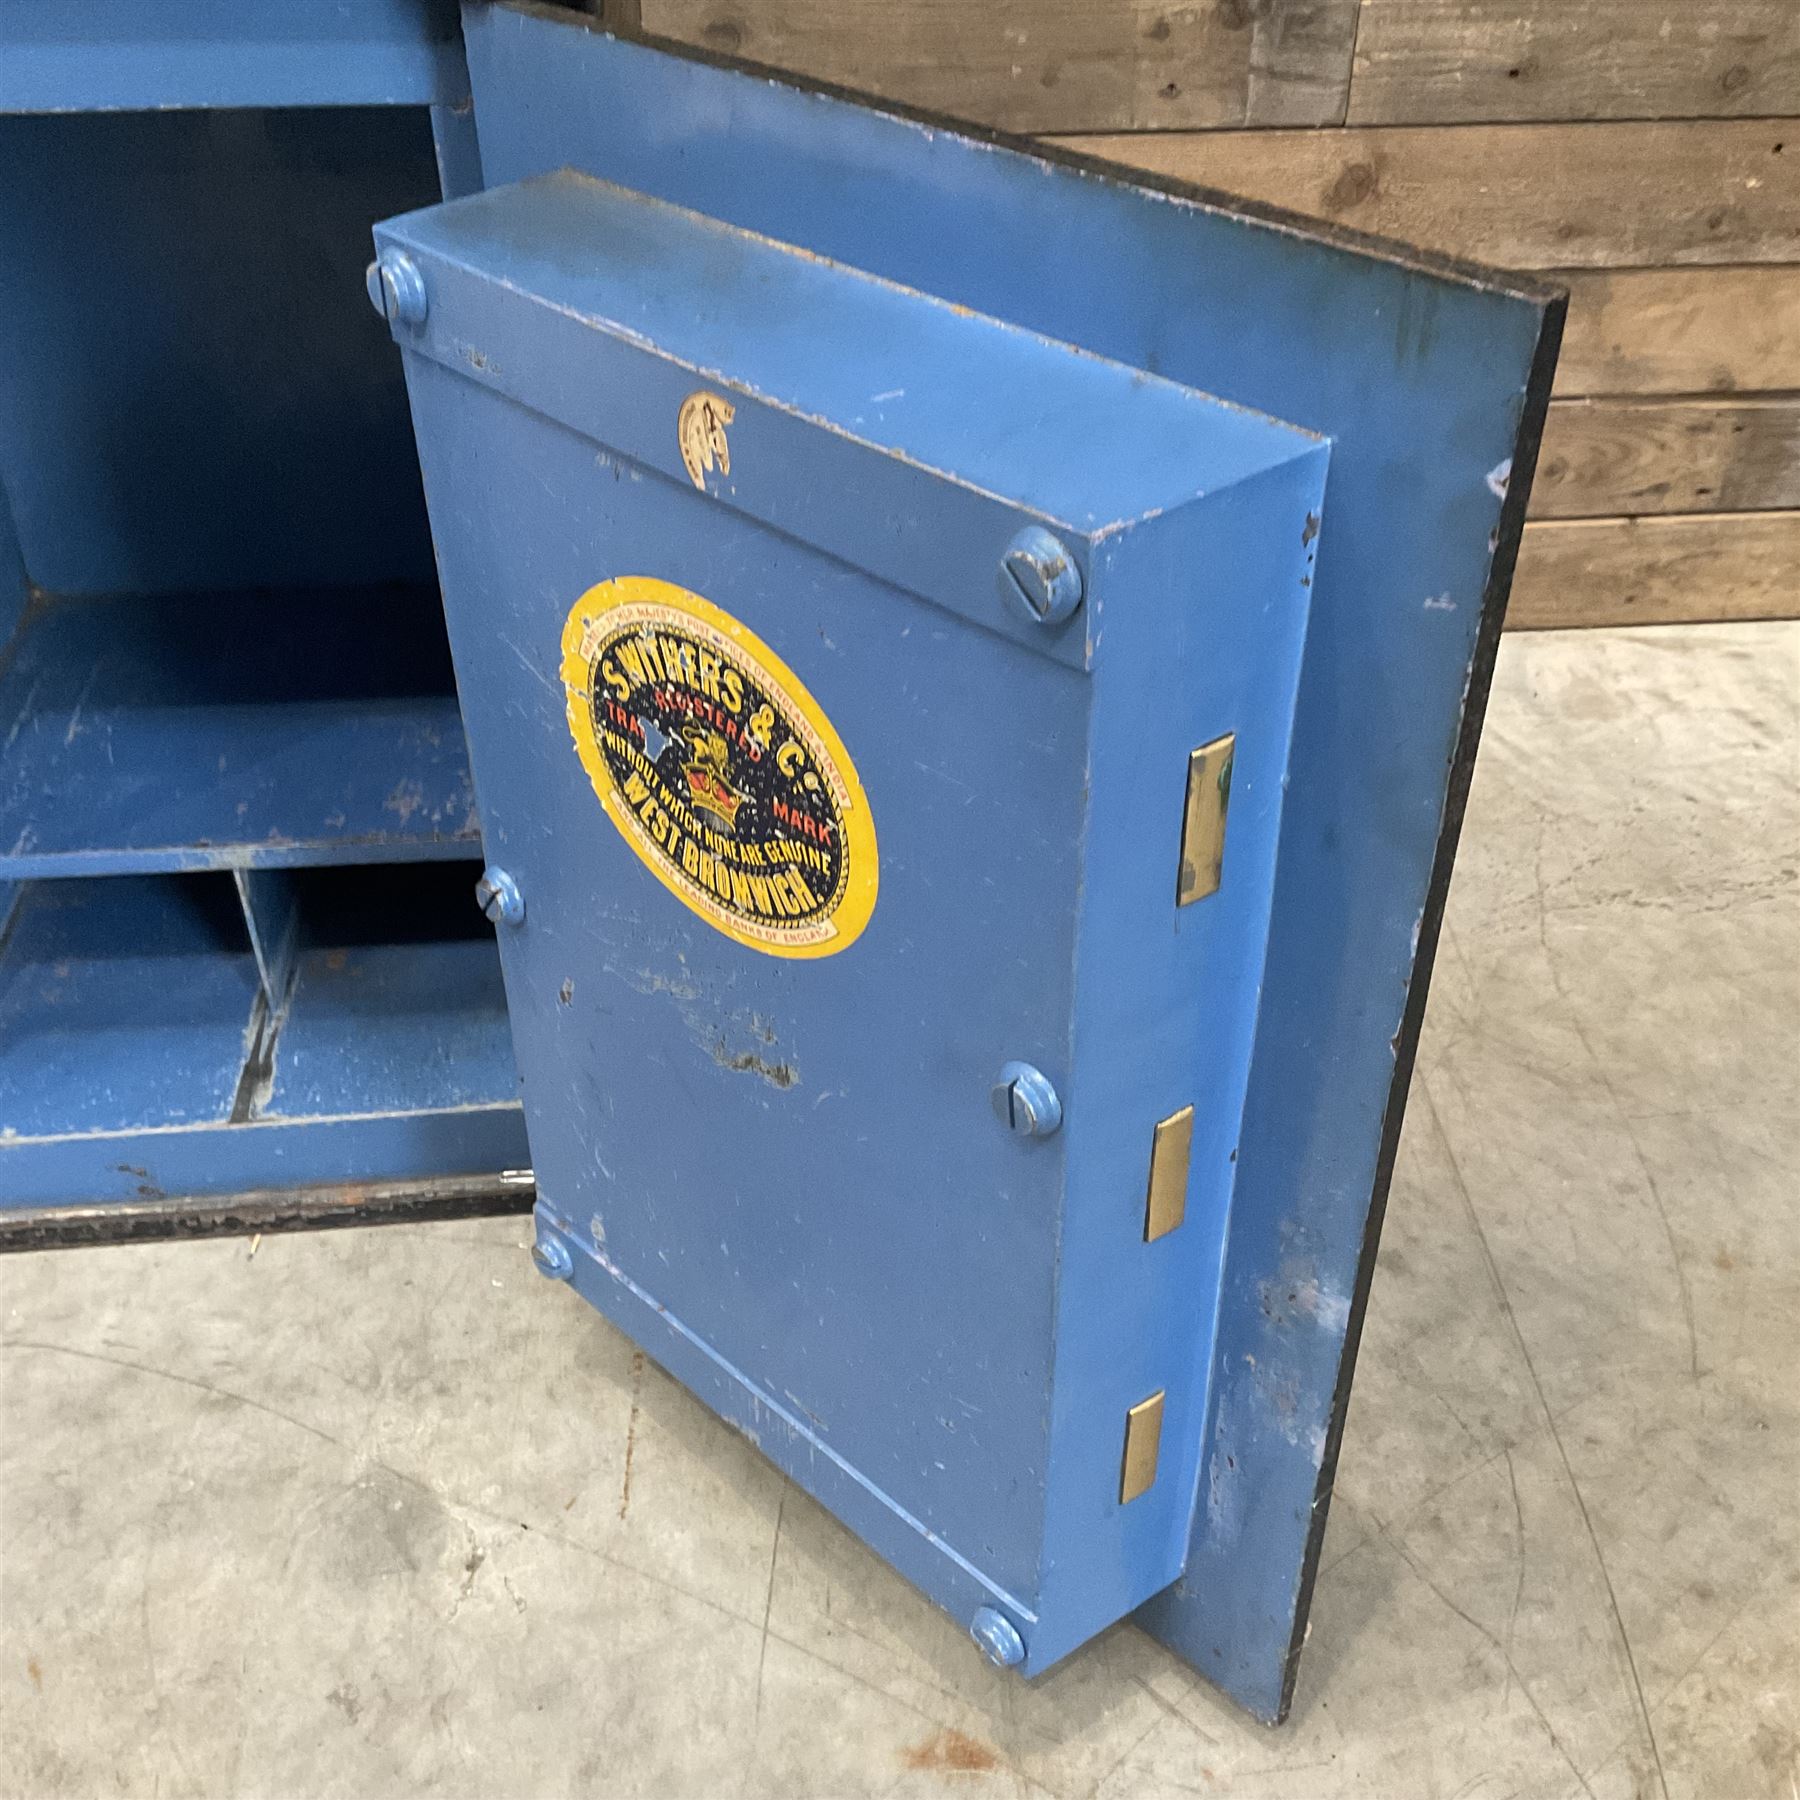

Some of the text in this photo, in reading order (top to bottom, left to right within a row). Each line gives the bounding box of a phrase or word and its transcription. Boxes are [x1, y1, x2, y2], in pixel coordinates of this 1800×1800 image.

[655, 687, 762, 762] REGISTERED
[750, 703, 775, 750] &
[769, 681, 814, 740] ENGLAND
[824, 755, 847, 801] INDIA
[605, 729, 832, 877] WITHOUT WHICH NONE ARE GENUINE
[606, 699, 832, 847] TRA MARK
[624, 771, 682, 855] WEST
[725, 913, 762, 937] BANKS
[765, 930, 777, 942] OF
